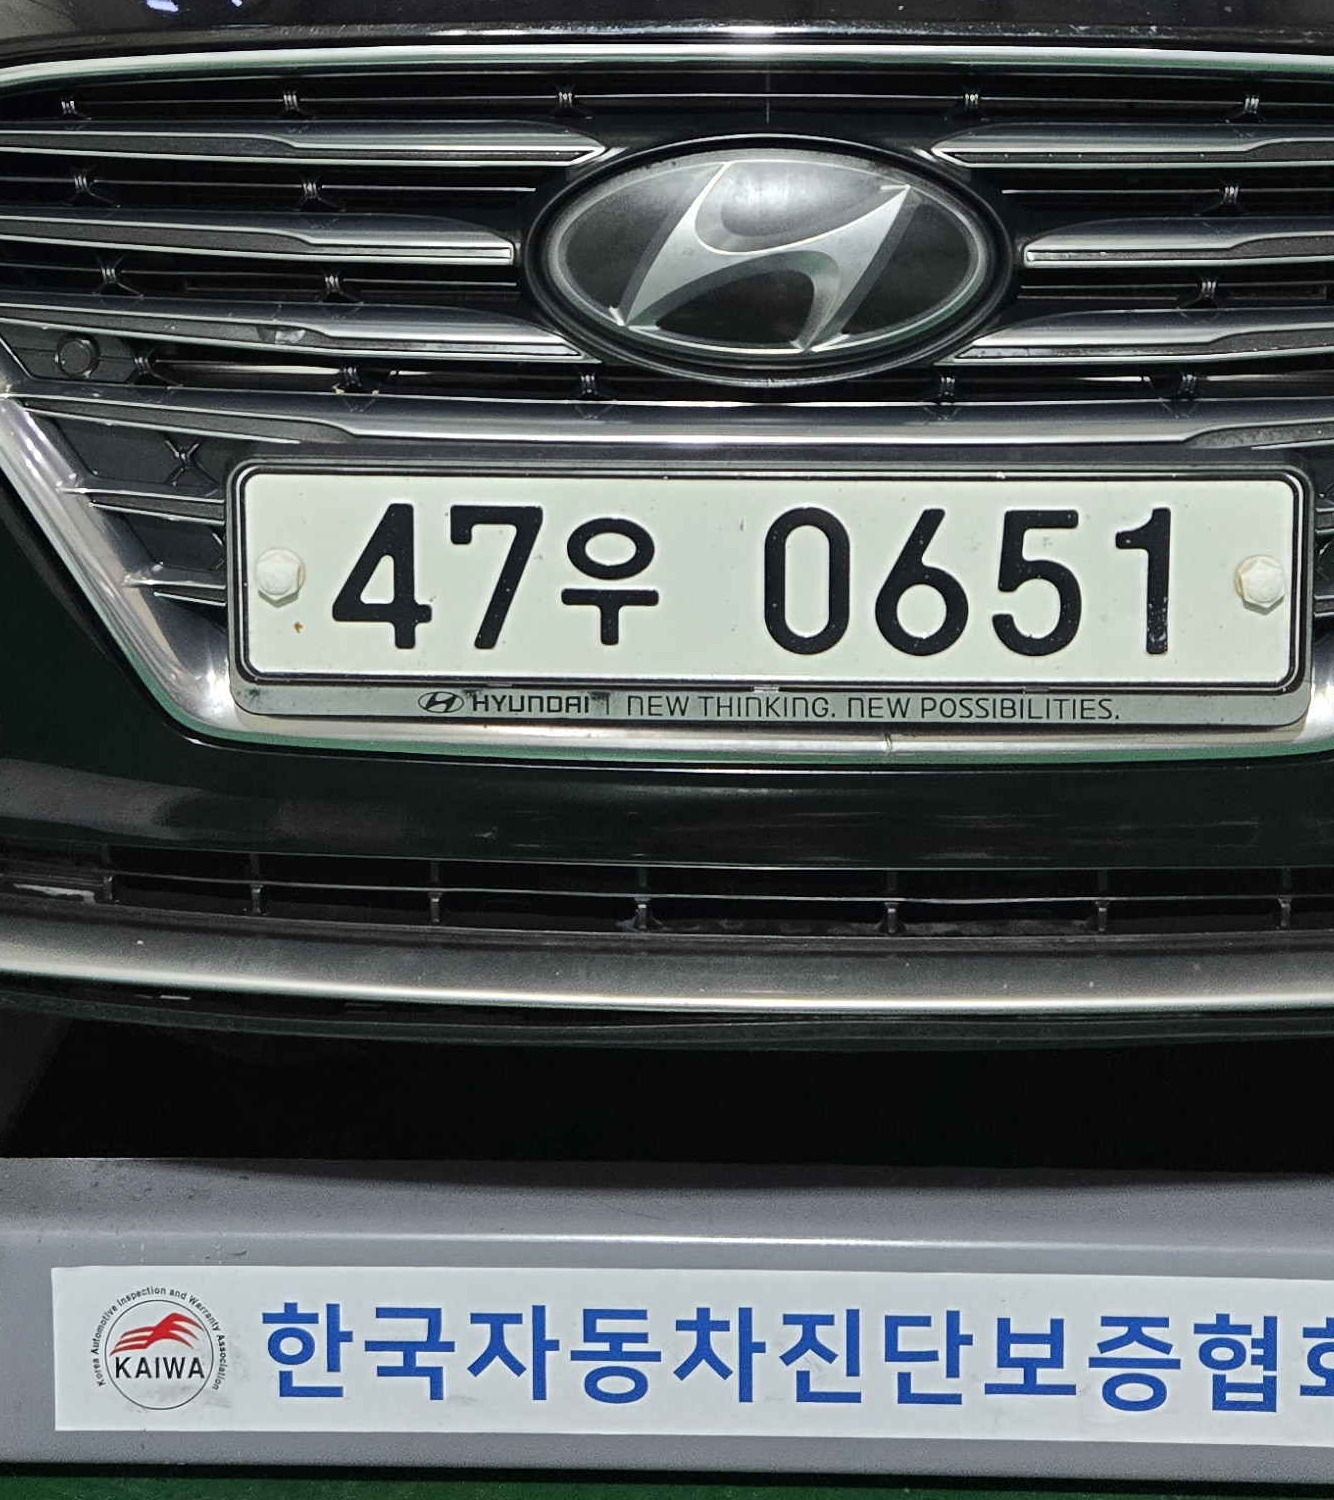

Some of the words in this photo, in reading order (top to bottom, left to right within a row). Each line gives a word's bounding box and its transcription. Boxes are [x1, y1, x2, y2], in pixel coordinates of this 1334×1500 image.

[763, 506, 1174, 657] 0651
[472, 694, 589, 714] HYUNDAI
[627, 695, 689, 717] NEW
[698, 695, 836, 719] THINKING.
[848, 697, 911, 718] NEW
[921, 698, 1120, 720] POSSIBILITIES.
[117, 1286, 166, 1307] Inspection
[169, 1288, 187, 1300] and
[189, 1295, 221, 1332] Warranty
[91, 1305, 119, 1355] Automotive
[93, 1358, 106, 1387] Korea
[115, 1356, 205, 1379] KAIWA
[212, 1334, 229, 1390] Association
